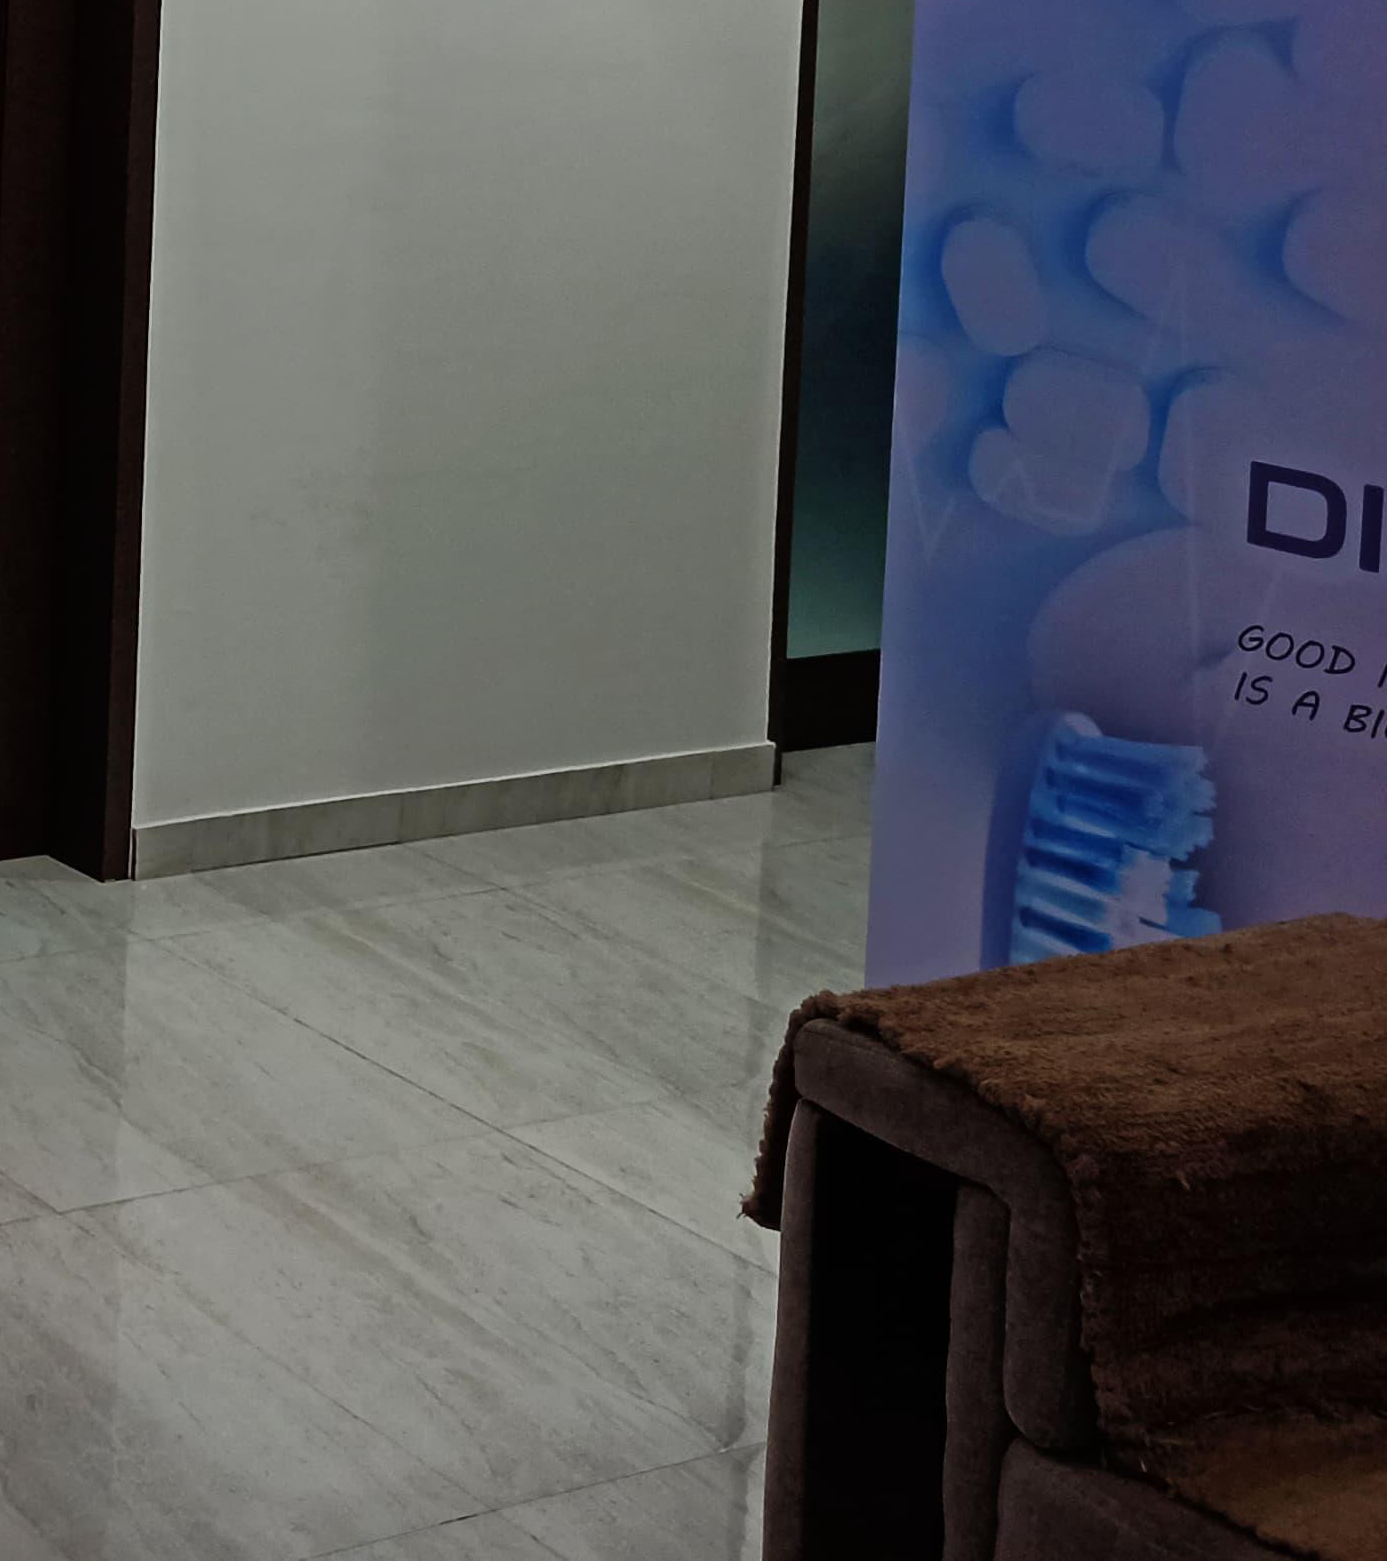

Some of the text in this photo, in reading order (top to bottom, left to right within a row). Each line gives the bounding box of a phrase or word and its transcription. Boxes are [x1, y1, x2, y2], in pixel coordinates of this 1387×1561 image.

[1237, 625, 1356, 675] GOOD
[1234, 671, 1273, 705] IS
[1291, 690, 1321, 721] A
